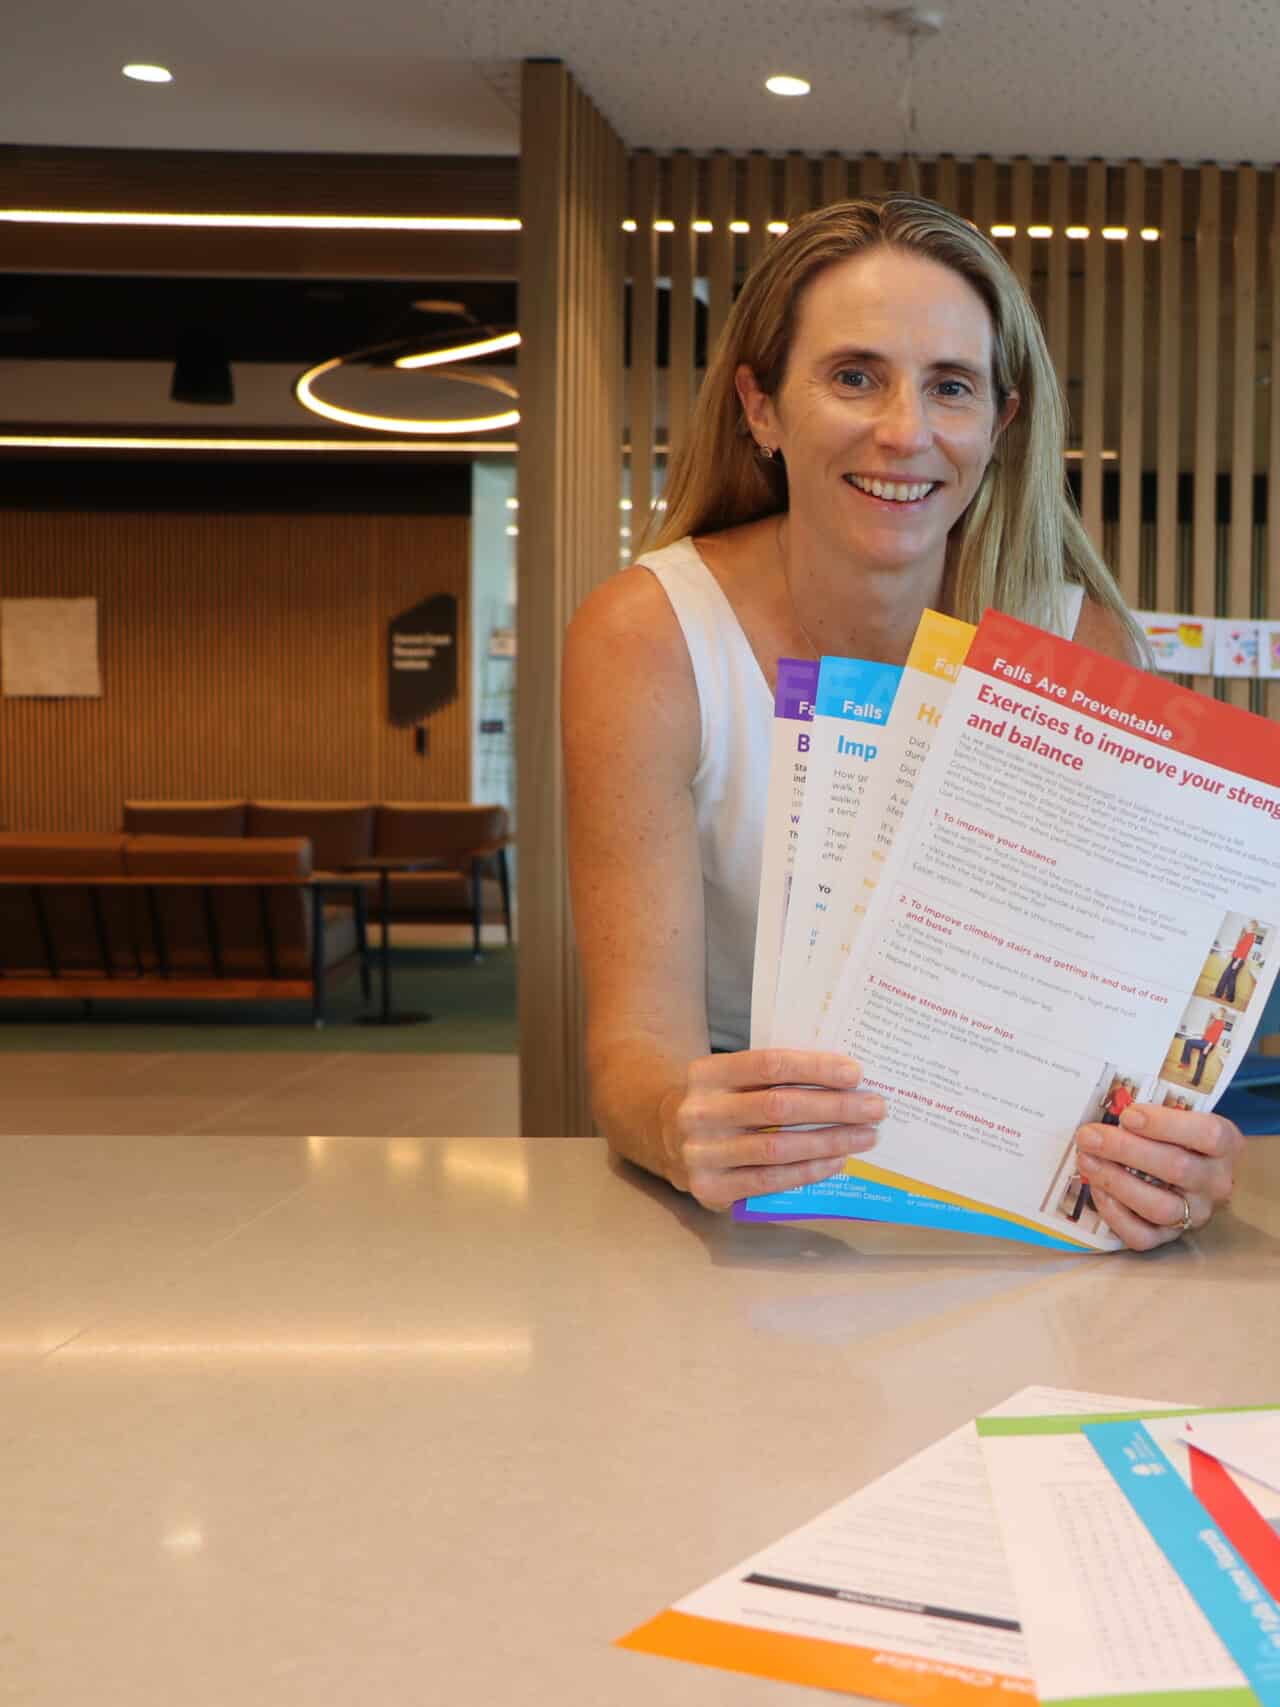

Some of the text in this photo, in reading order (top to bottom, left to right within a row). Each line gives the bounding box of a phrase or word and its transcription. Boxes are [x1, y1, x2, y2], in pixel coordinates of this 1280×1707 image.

[843, 700, 882, 719] Falls
[993, 658, 1172, 741] Falls Are Preventable
[837, 735, 877, 762] Imp
[967, 714, 1083, 770] and balance
[977, 684, 1070, 735] Exercises
[1074, 724, 1094, 745] to
[1097, 733, 1177, 778] improve
[1178, 770, 1225, 794] your
[940, 810, 956, 825] To
[956, 818, 995, 840] improve
[993, 833, 1021, 853] your
[1020, 845, 1057, 866] balance
[906, 912, 952, 935] and buses
[912, 899, 922, 910] To
[923, 905, 962, 927] improve
[963, 924, 1004, 946] climbing
[1007, 942, 1031, 956] stairs
[1033, 952, 1052, 963] and
[1053, 960, 1088, 978] getting
[1101, 978, 1119, 988] and
[878, 979, 916, 1001] Increase
[919, 998, 958, 1018] strength
[958, 1010, 971, 1024] in
[970, 1019, 993, 1032] your
[993, 1026, 1014, 1040] hips
[861, 1075, 1021, 1138] mprove walking and climbing stairs
